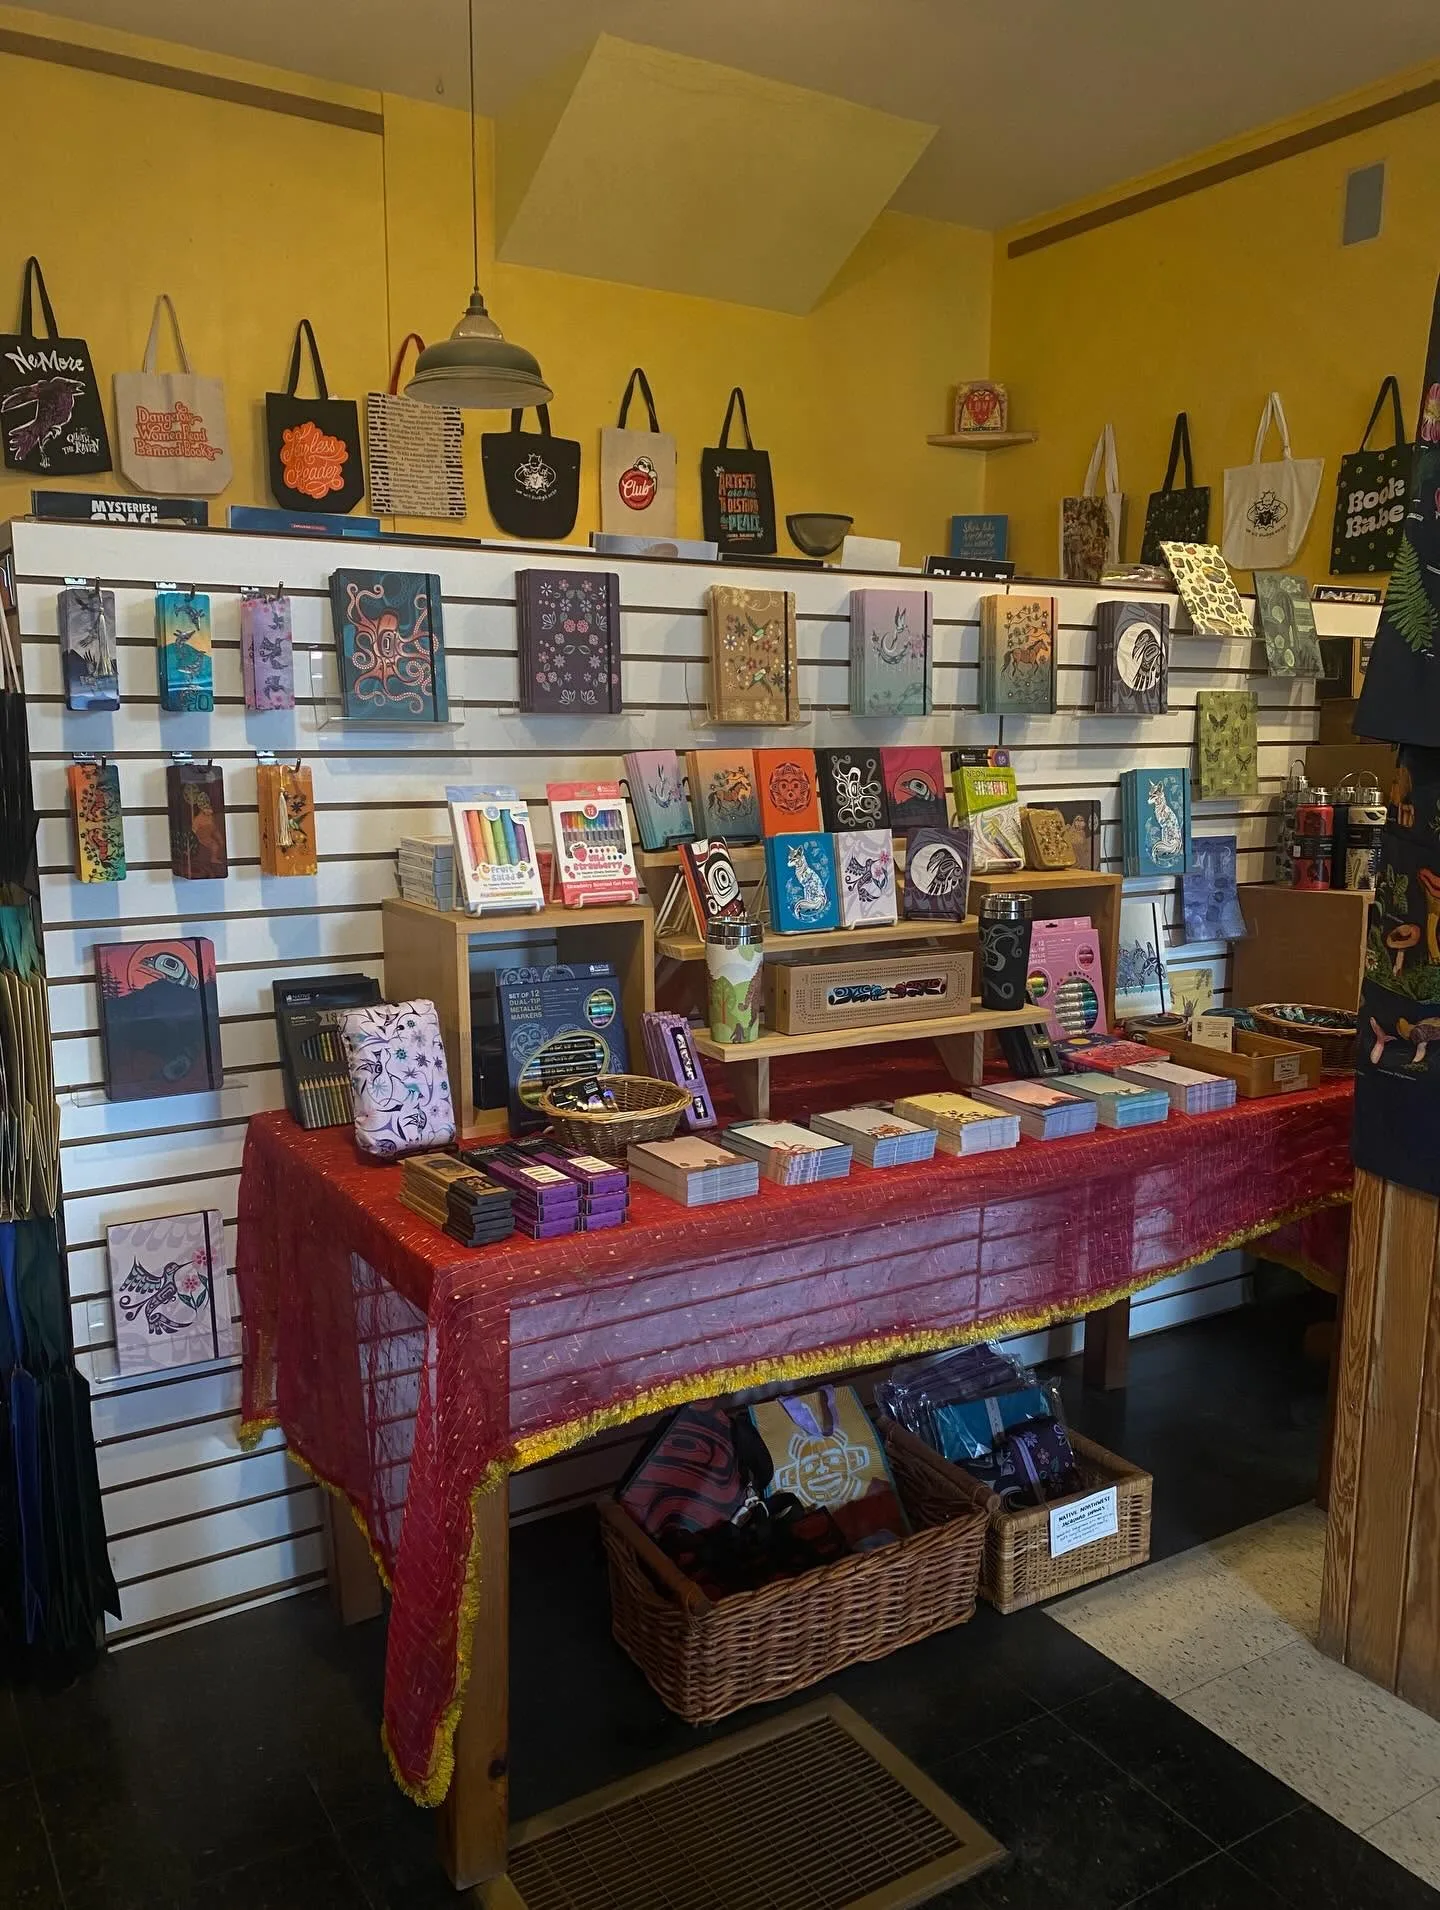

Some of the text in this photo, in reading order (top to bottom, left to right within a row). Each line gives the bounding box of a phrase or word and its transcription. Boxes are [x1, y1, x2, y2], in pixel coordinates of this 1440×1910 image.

[136, 423, 208, 441] Women Read
[75, 438, 100, 455] RAVEN
[134, 438, 223, 461] Banned Books
[286, 460, 343, 495] Reader
[622, 480, 654, 498] Club
[1348, 477, 1405, 514] Book
[91, 500, 151, 513] MYSTERIES
[1345, 504, 1405, 538] Babe
[966, 769, 986, 778] NEON
[491, 866, 514, 874] Fruit
[573, 861, 623, 871] Strawberry
[530, 989, 540, 997] 12
[509, 998, 541, 1006] DUAL-TIP
[510, 1005, 541, 1013] METALLIC
[510, 1012, 542, 1020] MARKERS
[1058, 1496, 1111, 1522] NATIVE NORTHWEST
